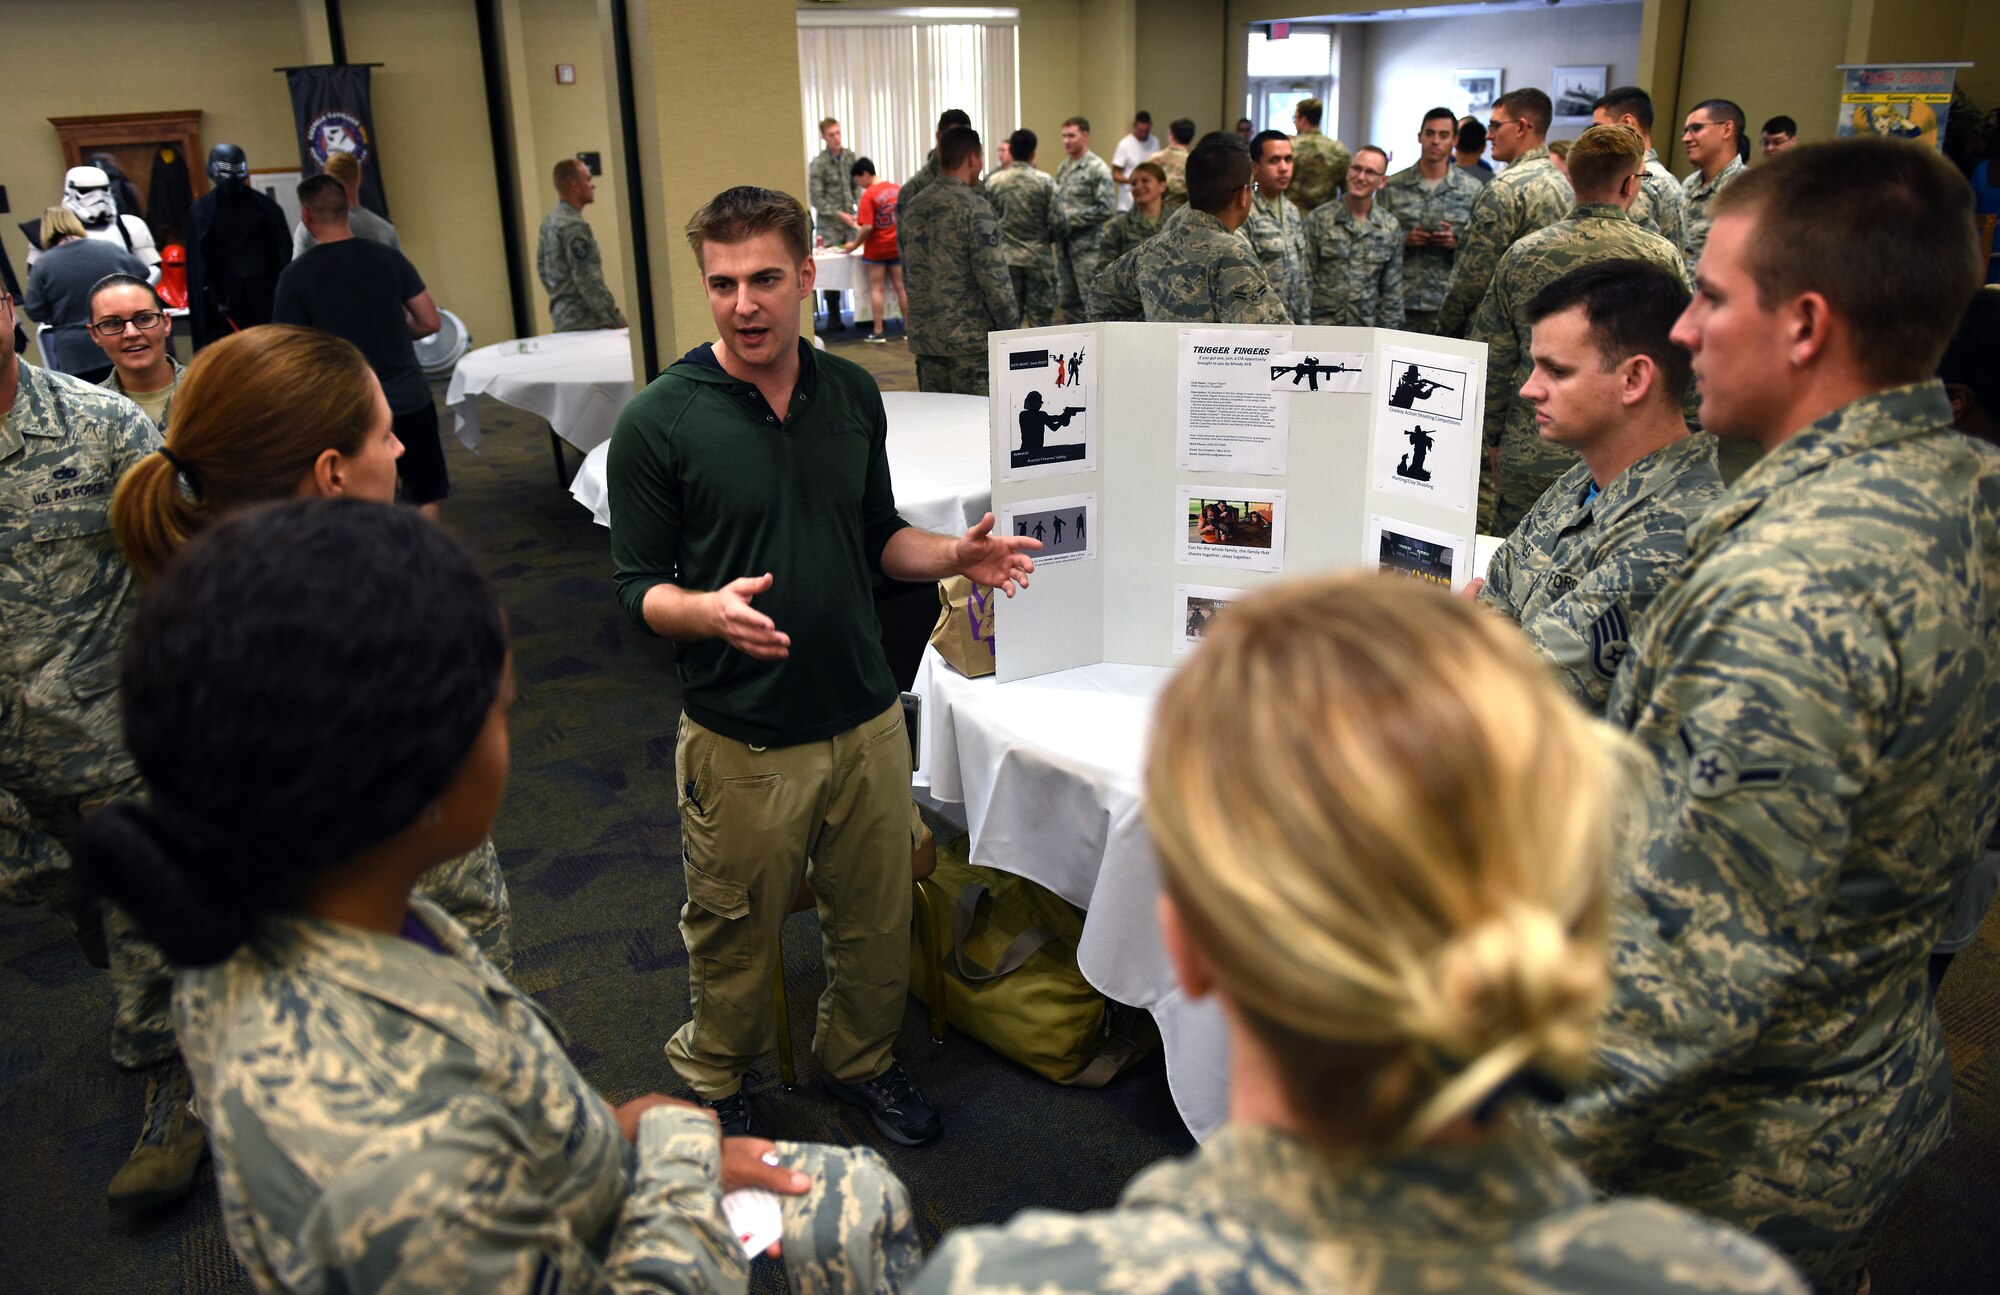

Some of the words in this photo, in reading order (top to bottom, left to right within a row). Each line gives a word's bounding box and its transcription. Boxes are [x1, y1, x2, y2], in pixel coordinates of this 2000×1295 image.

[1193, 346, 1230, 354] TRIGGER
[1233, 347, 1270, 355] FINGERS
[1418, 413, 1434, 421] Shooting
[1435, 416, 1461, 426] Competitions
[1416, 481, 1434, 490] Shooting
[33, 492, 52, 504] U.S.
[55, 488, 73, 501] AIR
[73, 482, 106, 497] FORCE
